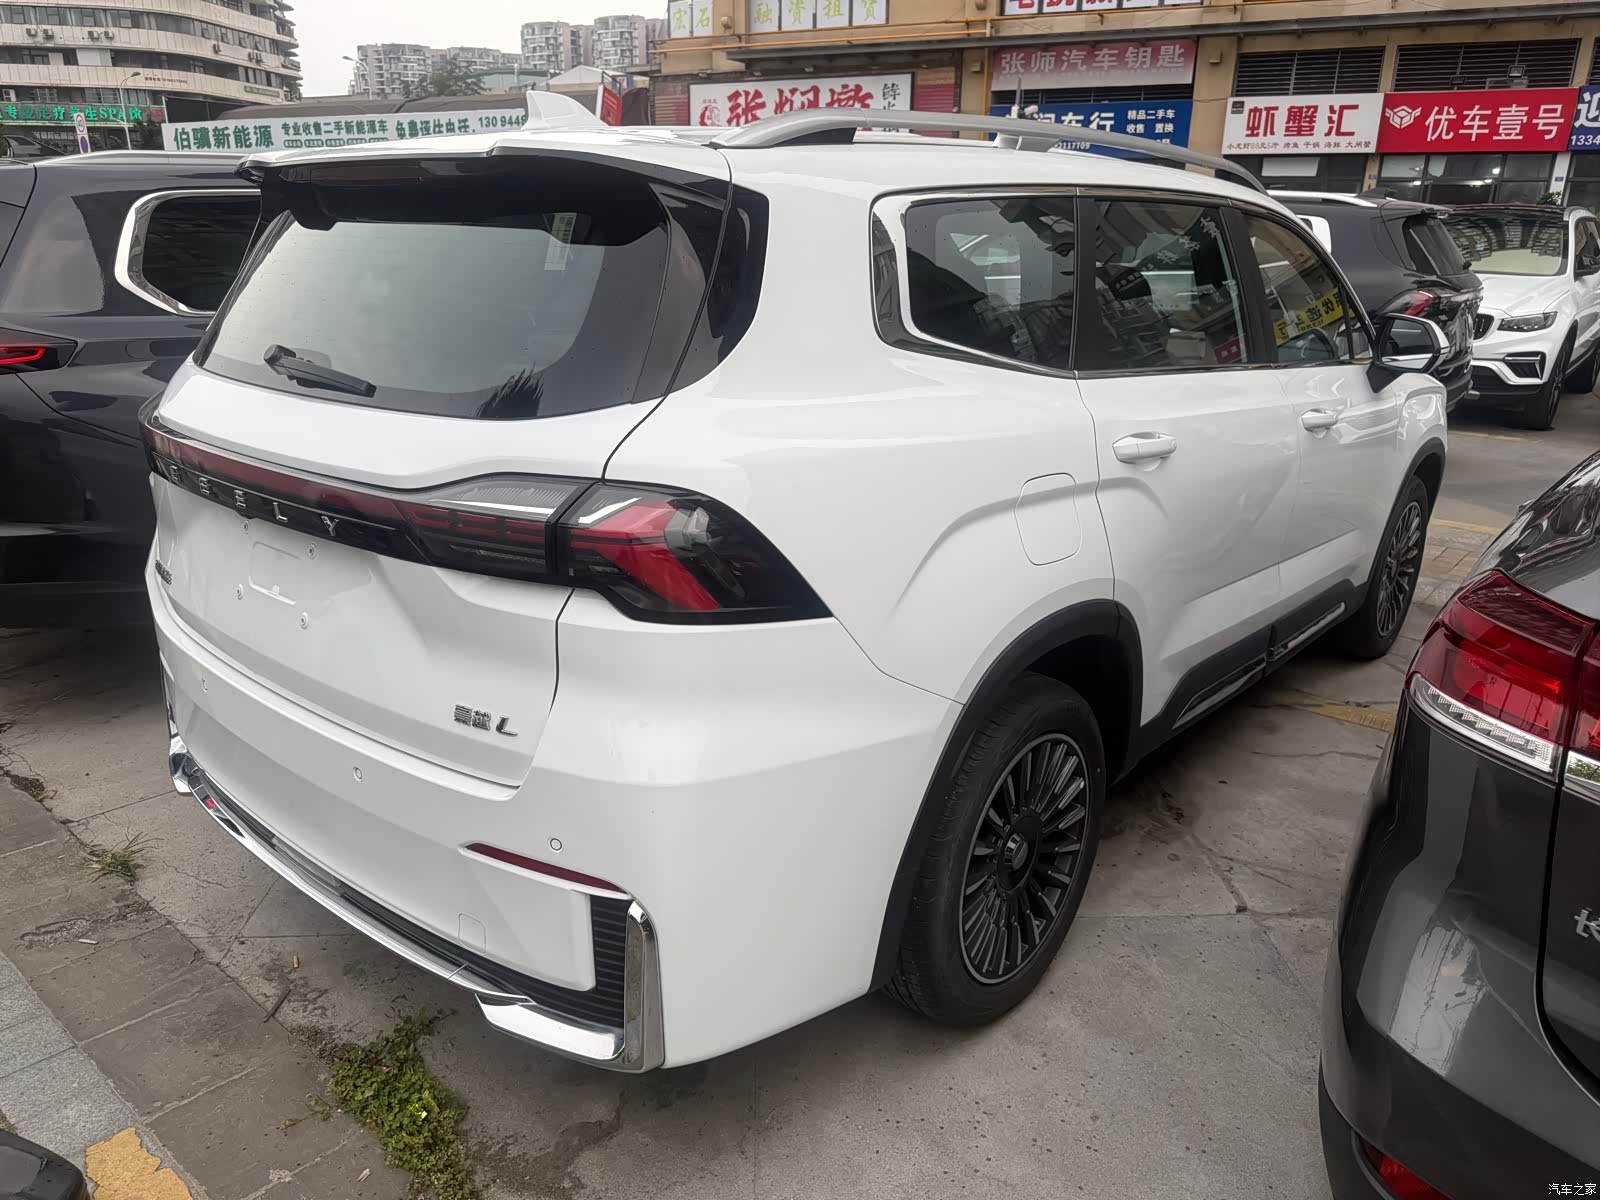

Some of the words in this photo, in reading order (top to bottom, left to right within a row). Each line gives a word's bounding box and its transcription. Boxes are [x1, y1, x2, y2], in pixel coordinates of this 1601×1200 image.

[1001, 44, 1186, 75] 张师汽车钥匙
[0, 103, 143, 121] 专业足疗养生SPA馆
[479, 116, 498, 128] 130
[1127, 109, 1176, 120] 精品二手车
[1245, 104, 1360, 138] 虾蟹汇
[281, 119, 389, 136] 专业收售二手新能源车
[1126, 123, 1145, 134] 收售
[1154, 123, 1175, 134] 置换
[1425, 103, 1565, 142] 优车壹号
[170, 465, 339, 537] GEELY
[495, 715, 519, 737] L
